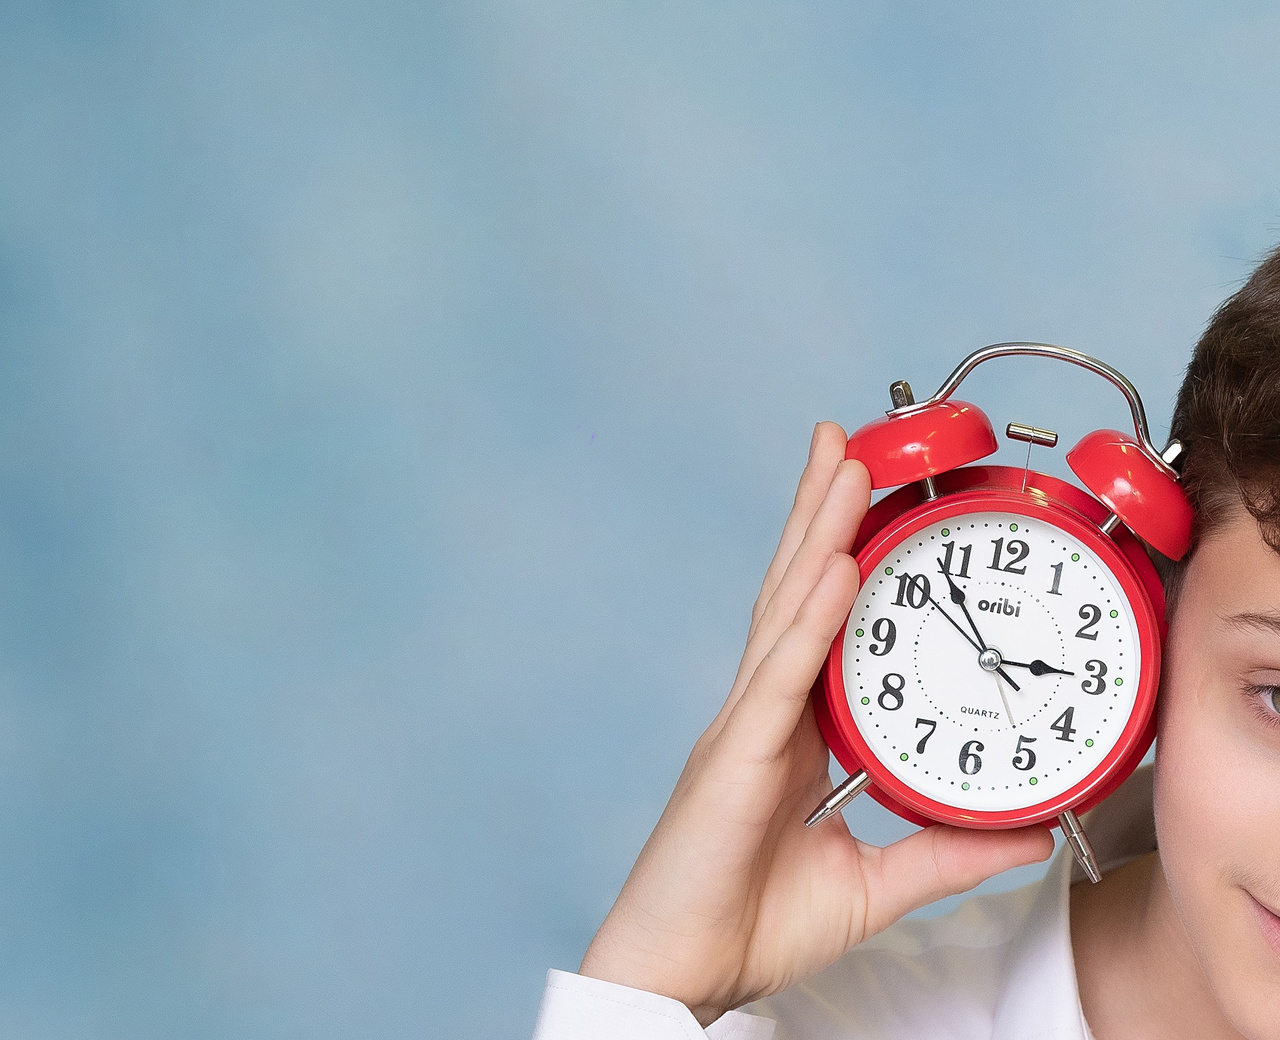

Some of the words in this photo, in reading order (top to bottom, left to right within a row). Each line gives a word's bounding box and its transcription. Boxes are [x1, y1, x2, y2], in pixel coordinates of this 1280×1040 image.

[938, 540, 973, 579] 11
[986, 537, 1030, 575] 12
[890, 572, 931, 609] 10
[1046, 561, 1064, 596] 1
[977, 597, 1021, 618] oribi
[1075, 604, 1102, 641] 2
[869, 617, 897, 656] 9
[877, 673, 906, 711] 8
[1081, 659, 1108, 695] 3
[960, 706, 1000, 720] QUARTZ
[1050, 706, 1077, 743] 4
[914, 717, 937, 754] 7
[1012, 735, 1037, 771] 5
[958, 740, 985, 775] 6
